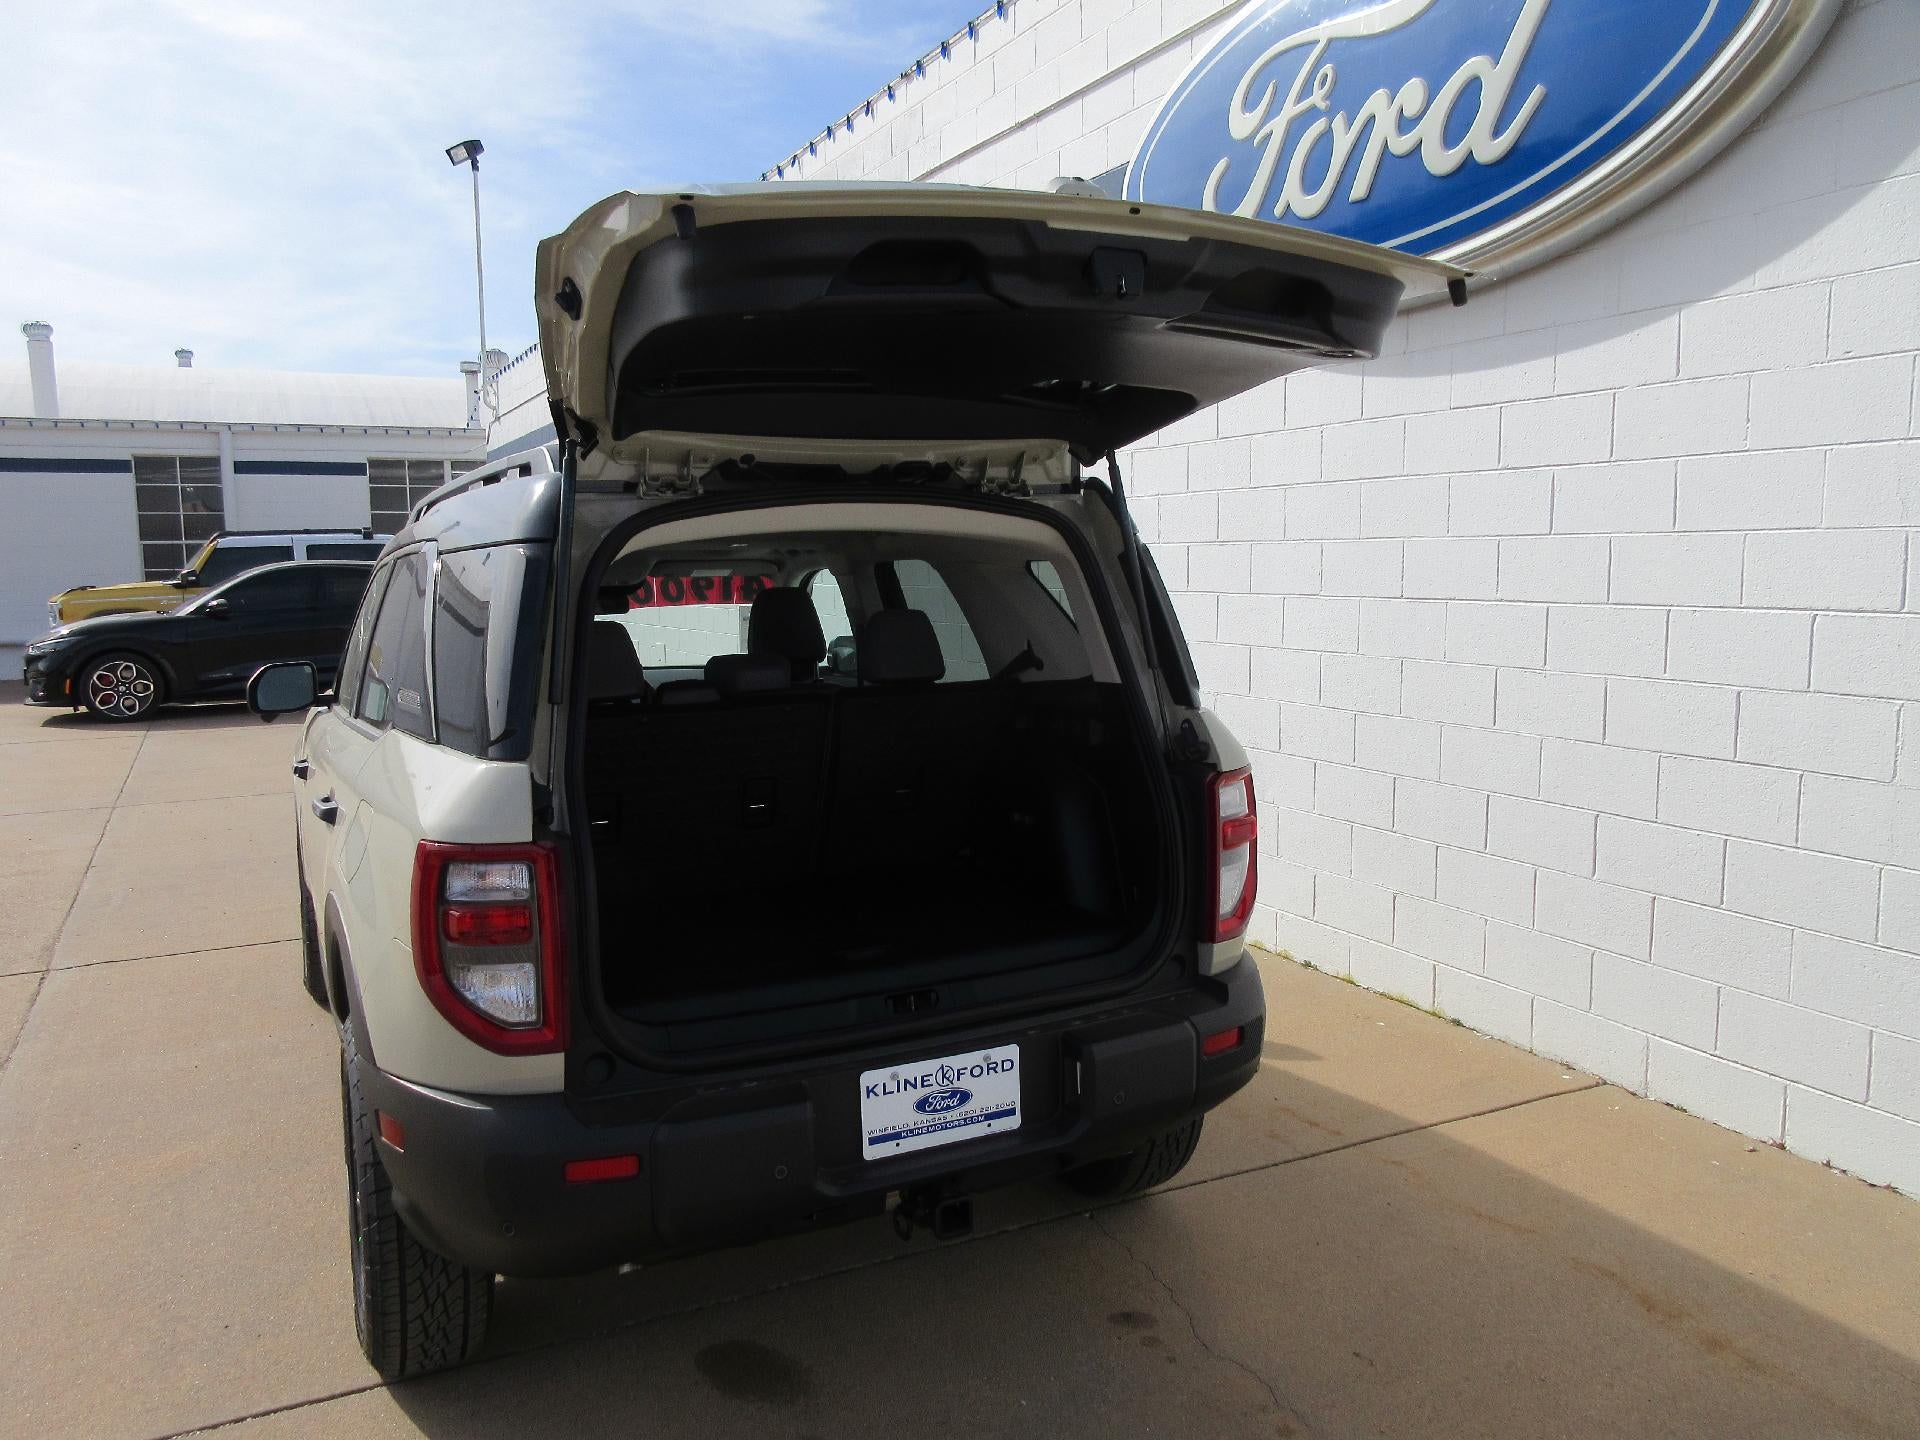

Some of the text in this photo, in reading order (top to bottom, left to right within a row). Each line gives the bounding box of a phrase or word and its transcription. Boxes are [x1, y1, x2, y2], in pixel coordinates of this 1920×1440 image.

[1202, 0, 1550, 220] Ford
[866, 1073, 933, 1099] KLINE
[956, 1058, 1015, 1082] FORD
[867, 1122, 911, 1136] WINFIELD,
[913, 1115, 948, 1127] KANSAS
[979, 1100, 1016, 1113] 221-2040
[925, 1091, 961, 1111] Ford
[901, 1115, 986, 1138] KLINEMOTORS.COM
